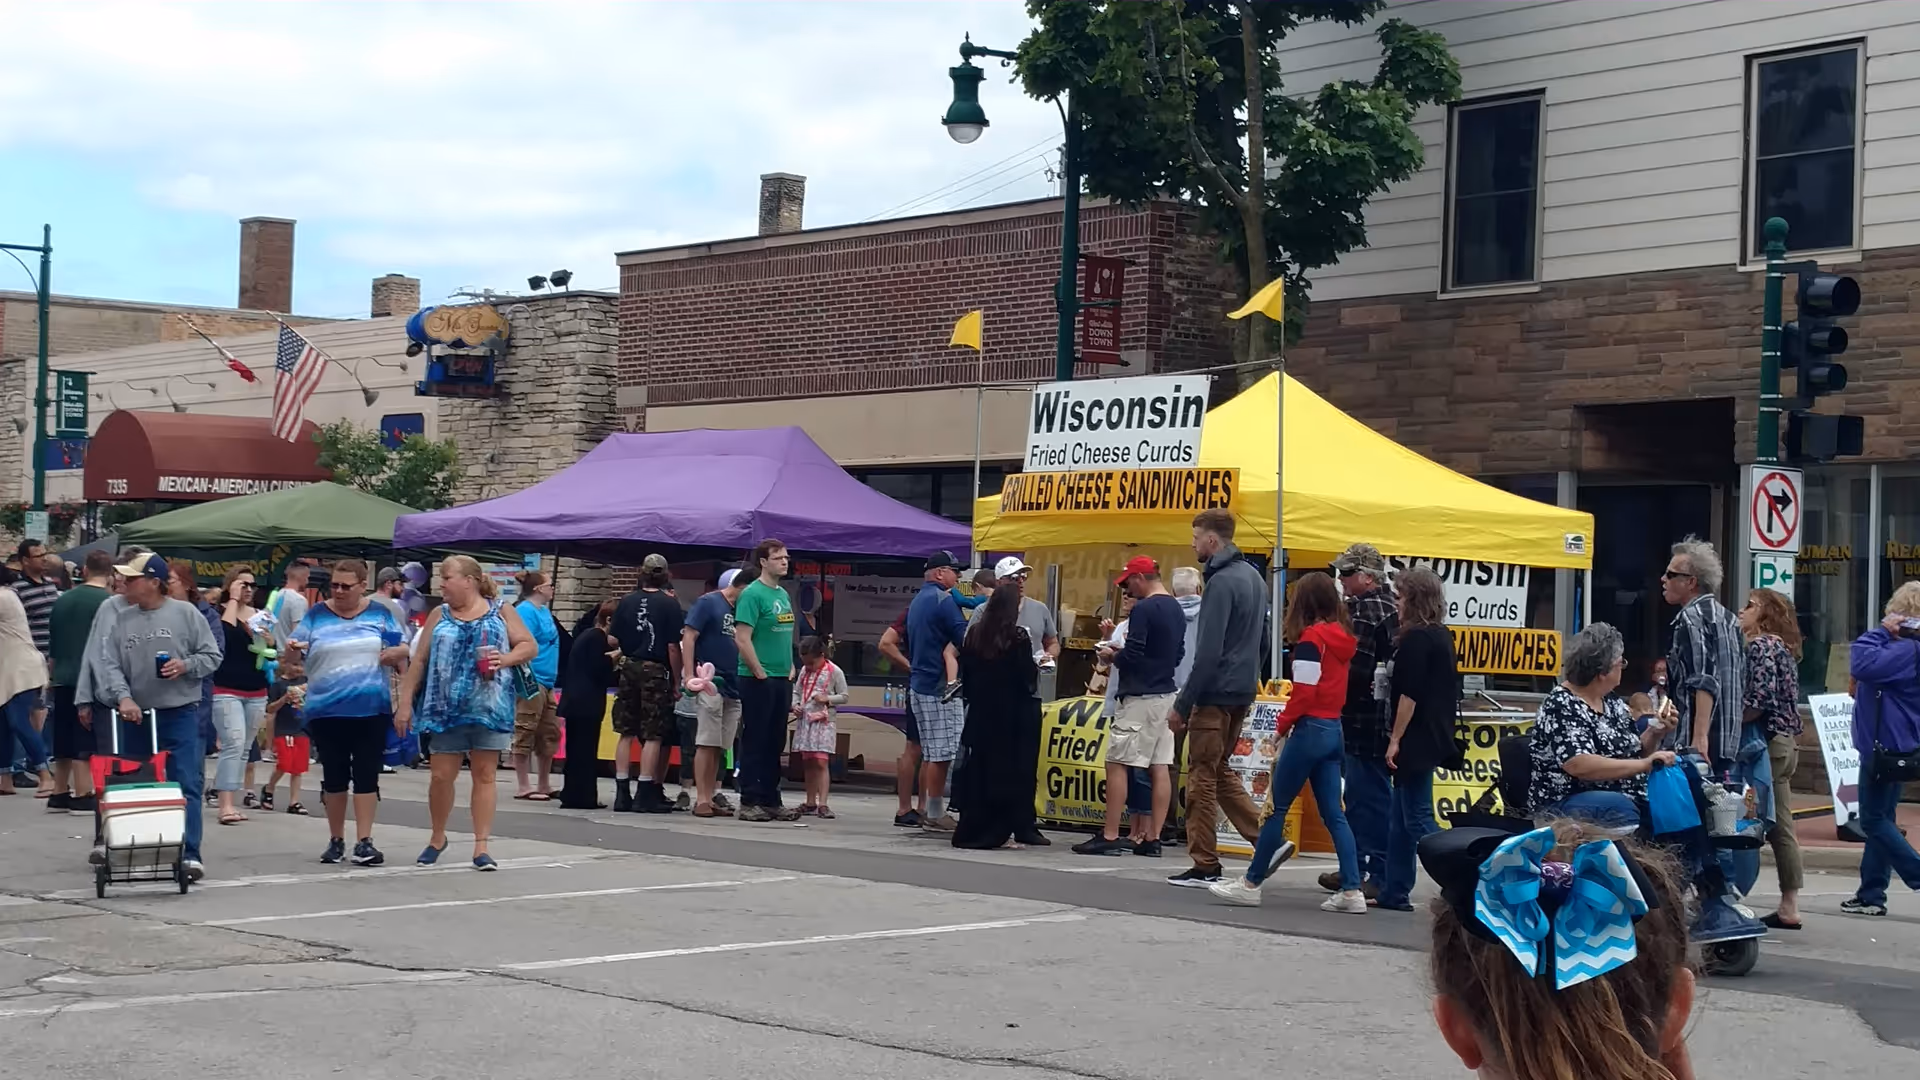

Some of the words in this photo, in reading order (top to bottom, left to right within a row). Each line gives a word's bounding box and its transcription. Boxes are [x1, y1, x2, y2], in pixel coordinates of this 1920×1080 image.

[1088, 328, 1113, 338] DOWN
[1088, 337, 1113, 347] TOWN
[1033, 384, 1205, 434] Wisconsin
[1029, 443, 1067, 467] Fried
[1071, 442, 1131, 465] Cheese
[1136, 439, 1193, 463] Curds
[107, 479, 128, 494] 7335
[158, 476, 269, 496] MEXICAN-AMERICAN
[1001, 474, 1054, 512] GRILLED
[1055, 472, 1114, 510] CHEESE
[1117, 470, 1232, 510] SANDWICHES
[1759, 563, 1777, 588] P
[1465, 597, 1518, 621] Curds
[1048, 727, 1104, 762] Fried
